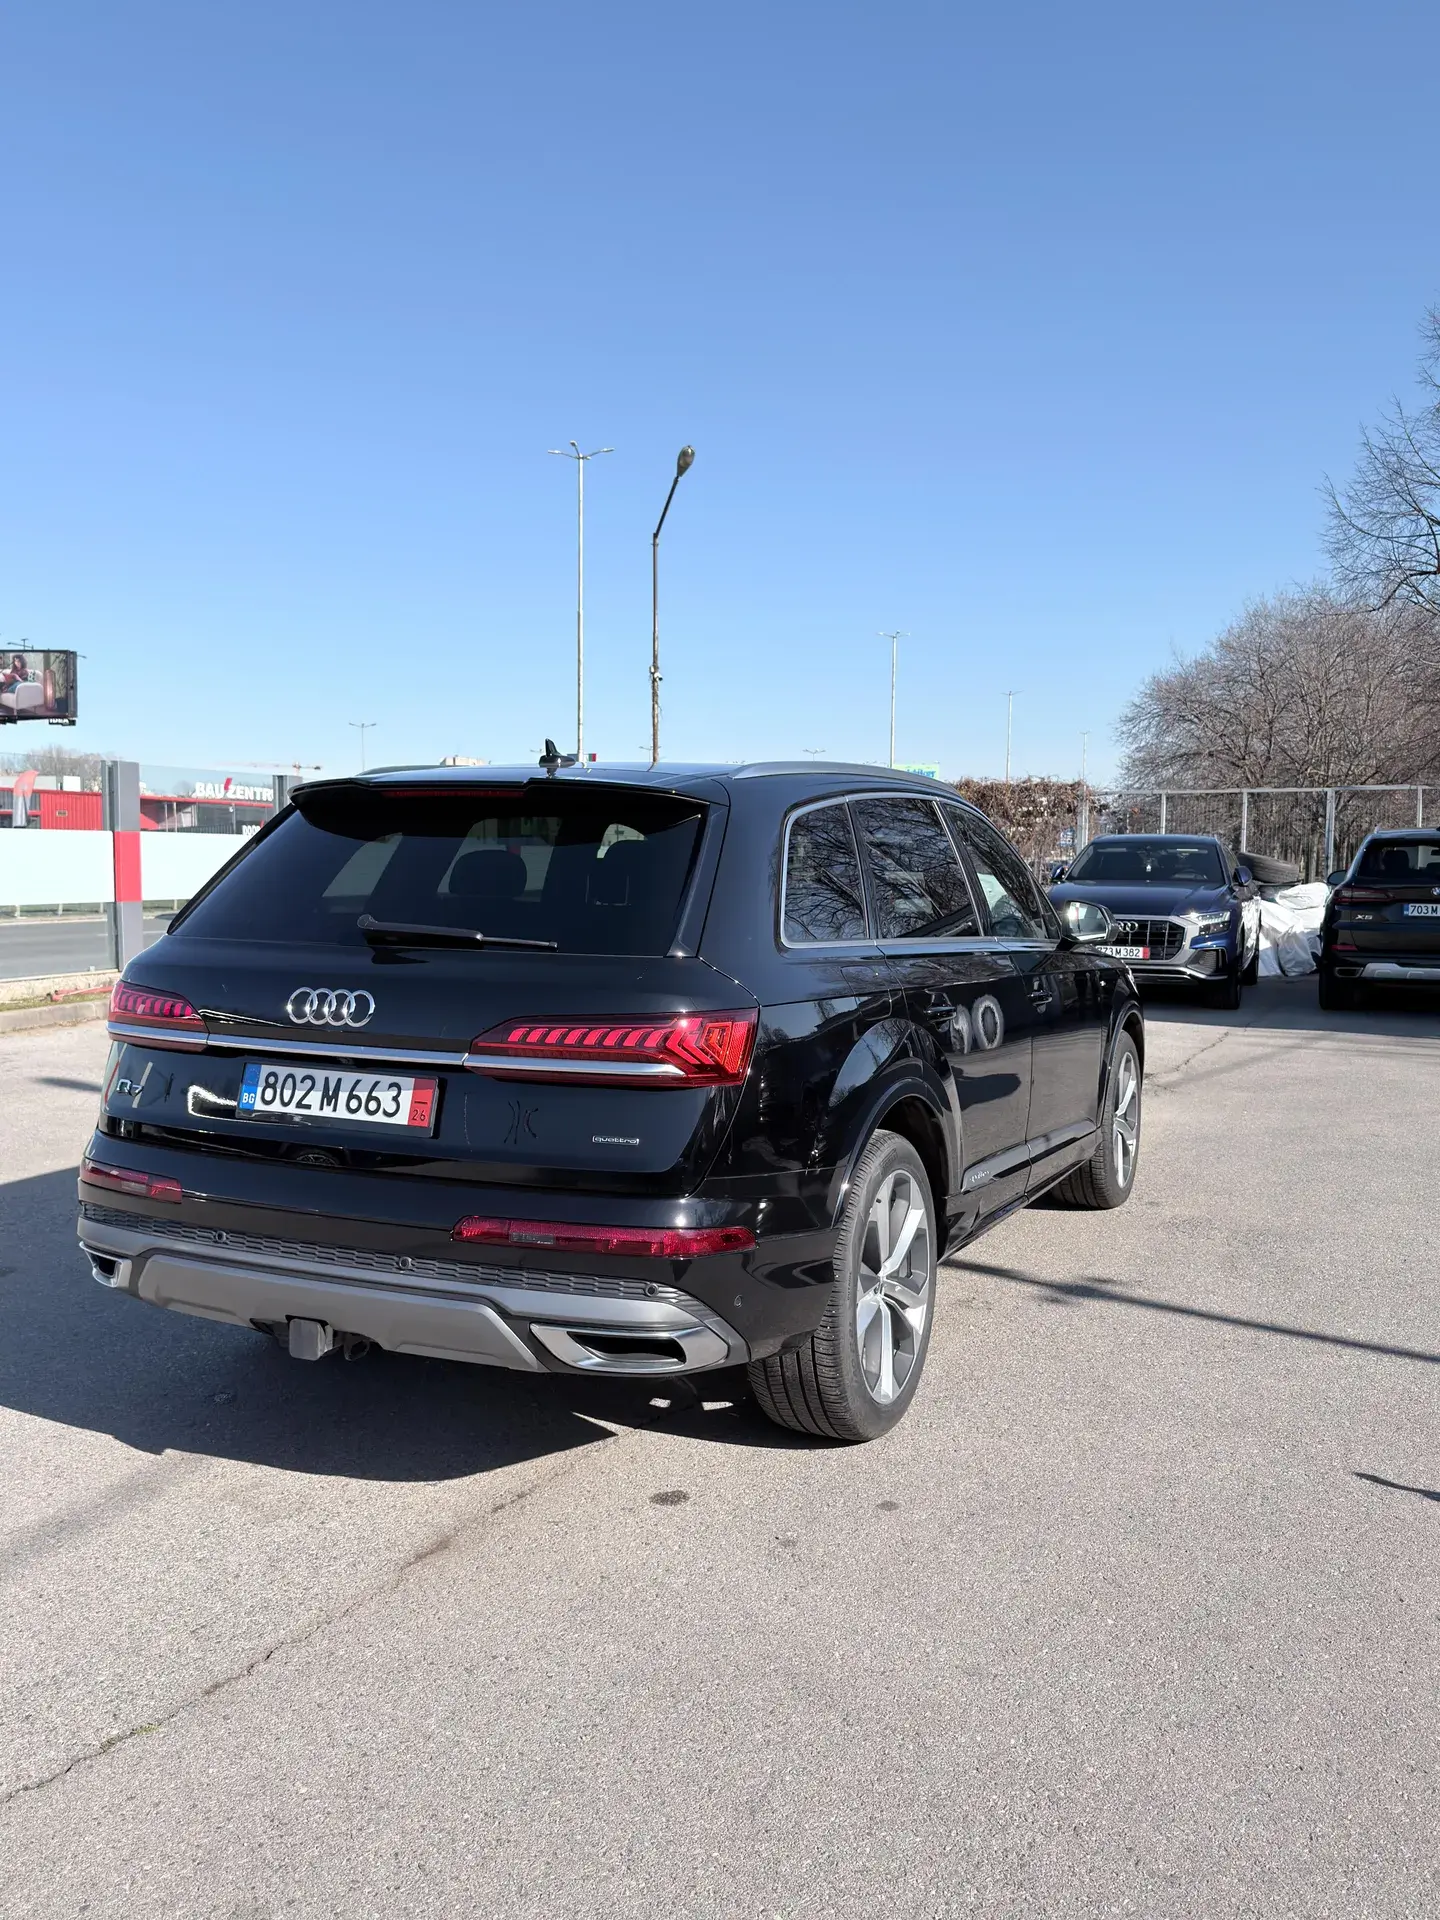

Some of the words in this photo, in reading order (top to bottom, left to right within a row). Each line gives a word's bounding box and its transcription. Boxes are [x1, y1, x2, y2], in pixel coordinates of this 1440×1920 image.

[1410, 905, 1428, 915] 703
[1123, 948, 1141, 958] 382
[116, 1078, 145, 1097] Q7
[242, 1093, 255, 1104] BG
[260, 1071, 316, 1110] 802
[345, 1079, 402, 1118] 663
[411, 1109, 426, 1122] 26
[594, 1136, 637, 1144] quattro
